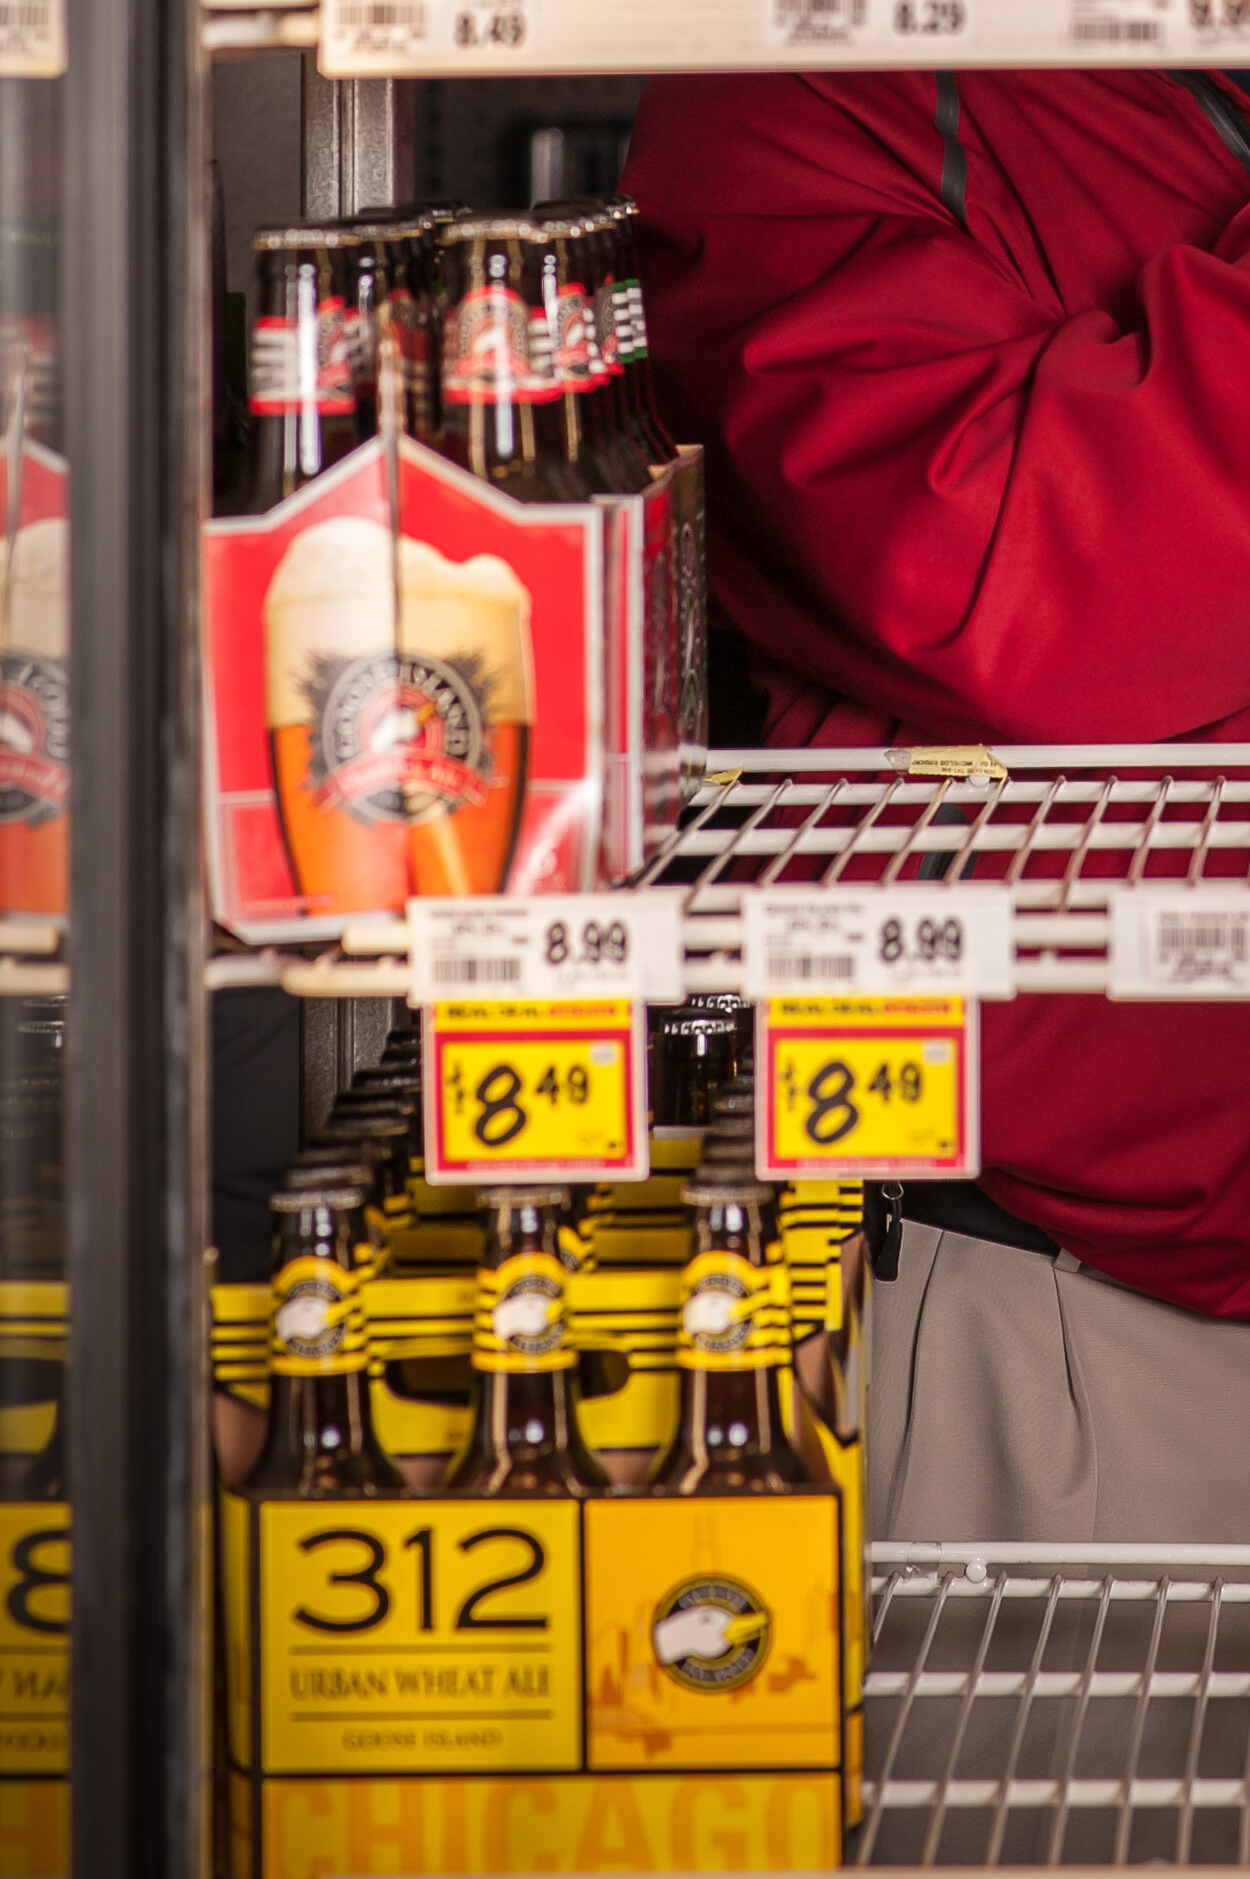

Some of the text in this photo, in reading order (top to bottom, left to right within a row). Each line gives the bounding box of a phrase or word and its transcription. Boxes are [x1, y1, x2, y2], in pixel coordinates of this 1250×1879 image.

[546, 919, 627, 965] 8.99
[878, 917, 962, 963] 8.99
[294, 1527, 549, 1633] 312
[290, 1663, 551, 1701] URBAN WHEAT ALE
[278, 1776, 837, 1875] CHICAGO
